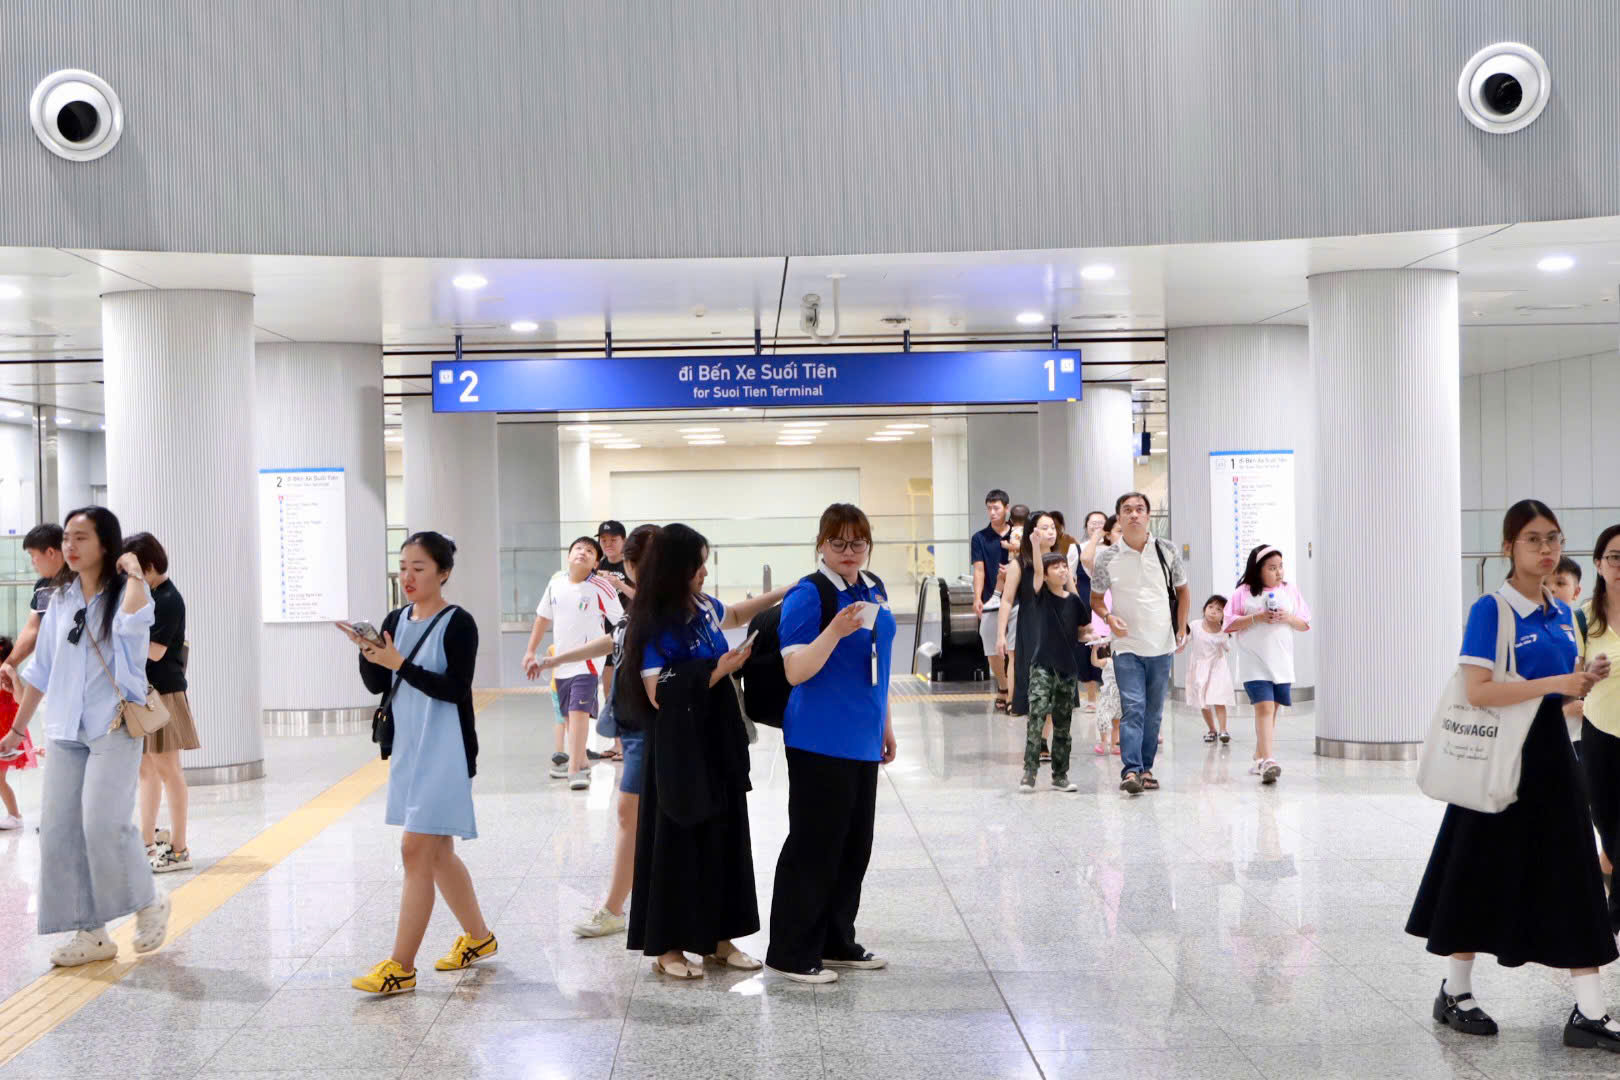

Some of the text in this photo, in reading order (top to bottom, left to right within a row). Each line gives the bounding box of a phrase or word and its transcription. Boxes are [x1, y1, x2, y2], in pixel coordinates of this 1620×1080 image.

[679, 362, 837, 381] đi Bến Xe Suối Tiên
[1044, 359, 1055, 392] 1
[459, 370, 479, 402] 2
[693, 384, 823, 398] for Suoi Tien Terminal
[1231, 458, 1235, 470] 1
[276, 476, 283, 488] 2
